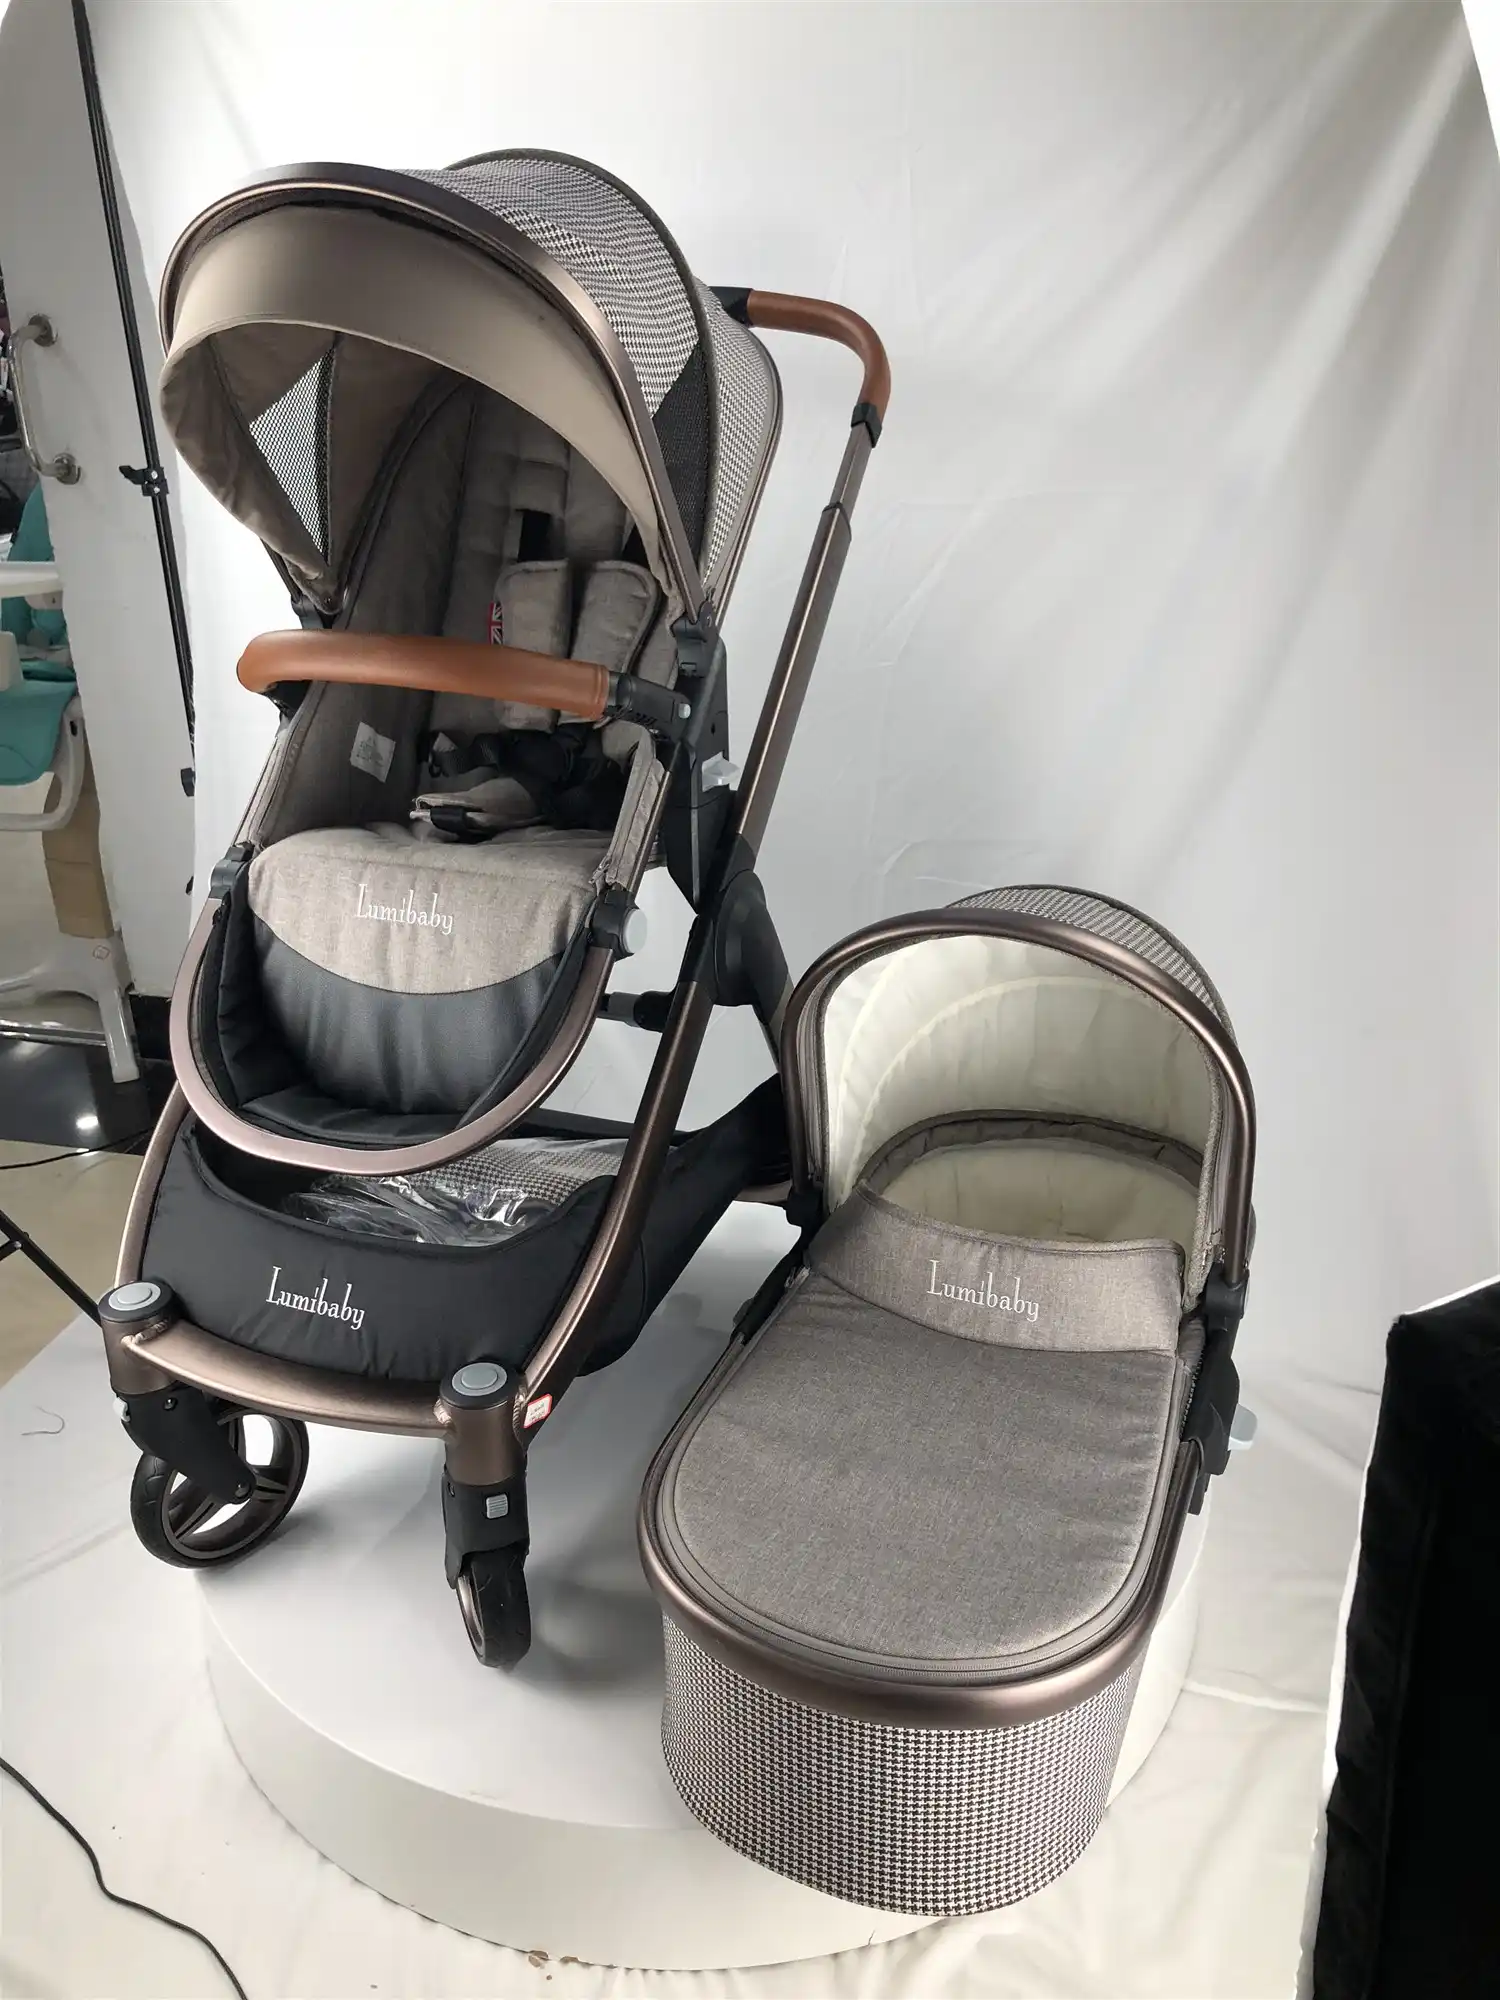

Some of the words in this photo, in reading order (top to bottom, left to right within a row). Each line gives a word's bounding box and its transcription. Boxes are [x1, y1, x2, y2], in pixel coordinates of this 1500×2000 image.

[355, 883, 454, 935] Lumibaby
[266, 1265, 366, 1331] Lumibaby
[927, 1259, 1040, 1322] Lumibaby
